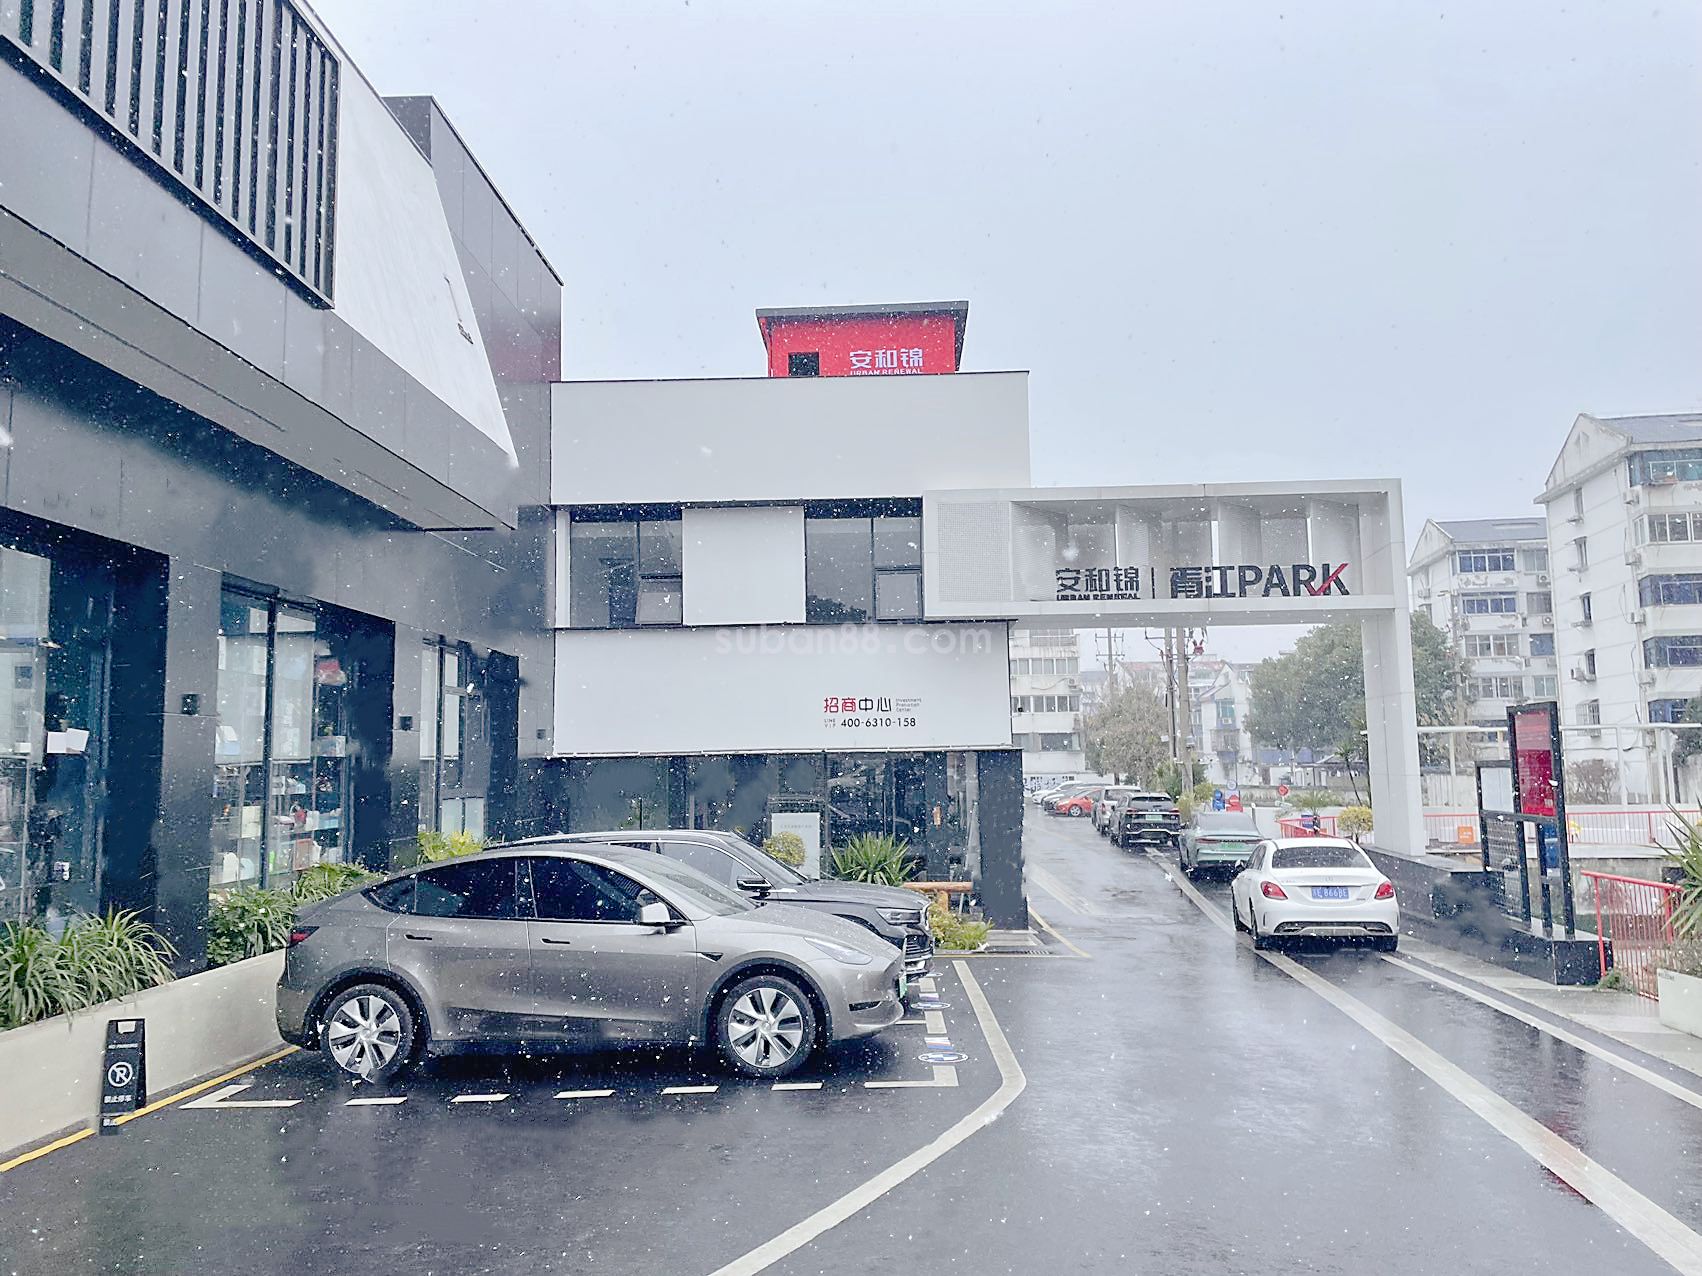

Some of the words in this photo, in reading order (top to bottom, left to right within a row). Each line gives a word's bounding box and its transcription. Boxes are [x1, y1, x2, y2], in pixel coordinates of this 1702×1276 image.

[849, 348, 923, 369] 安和锦
[1055, 566, 1140, 593] 安和锦
[824, 697, 891, 713] 招商中心
[841, 717, 916, 727] 400-6310-158
